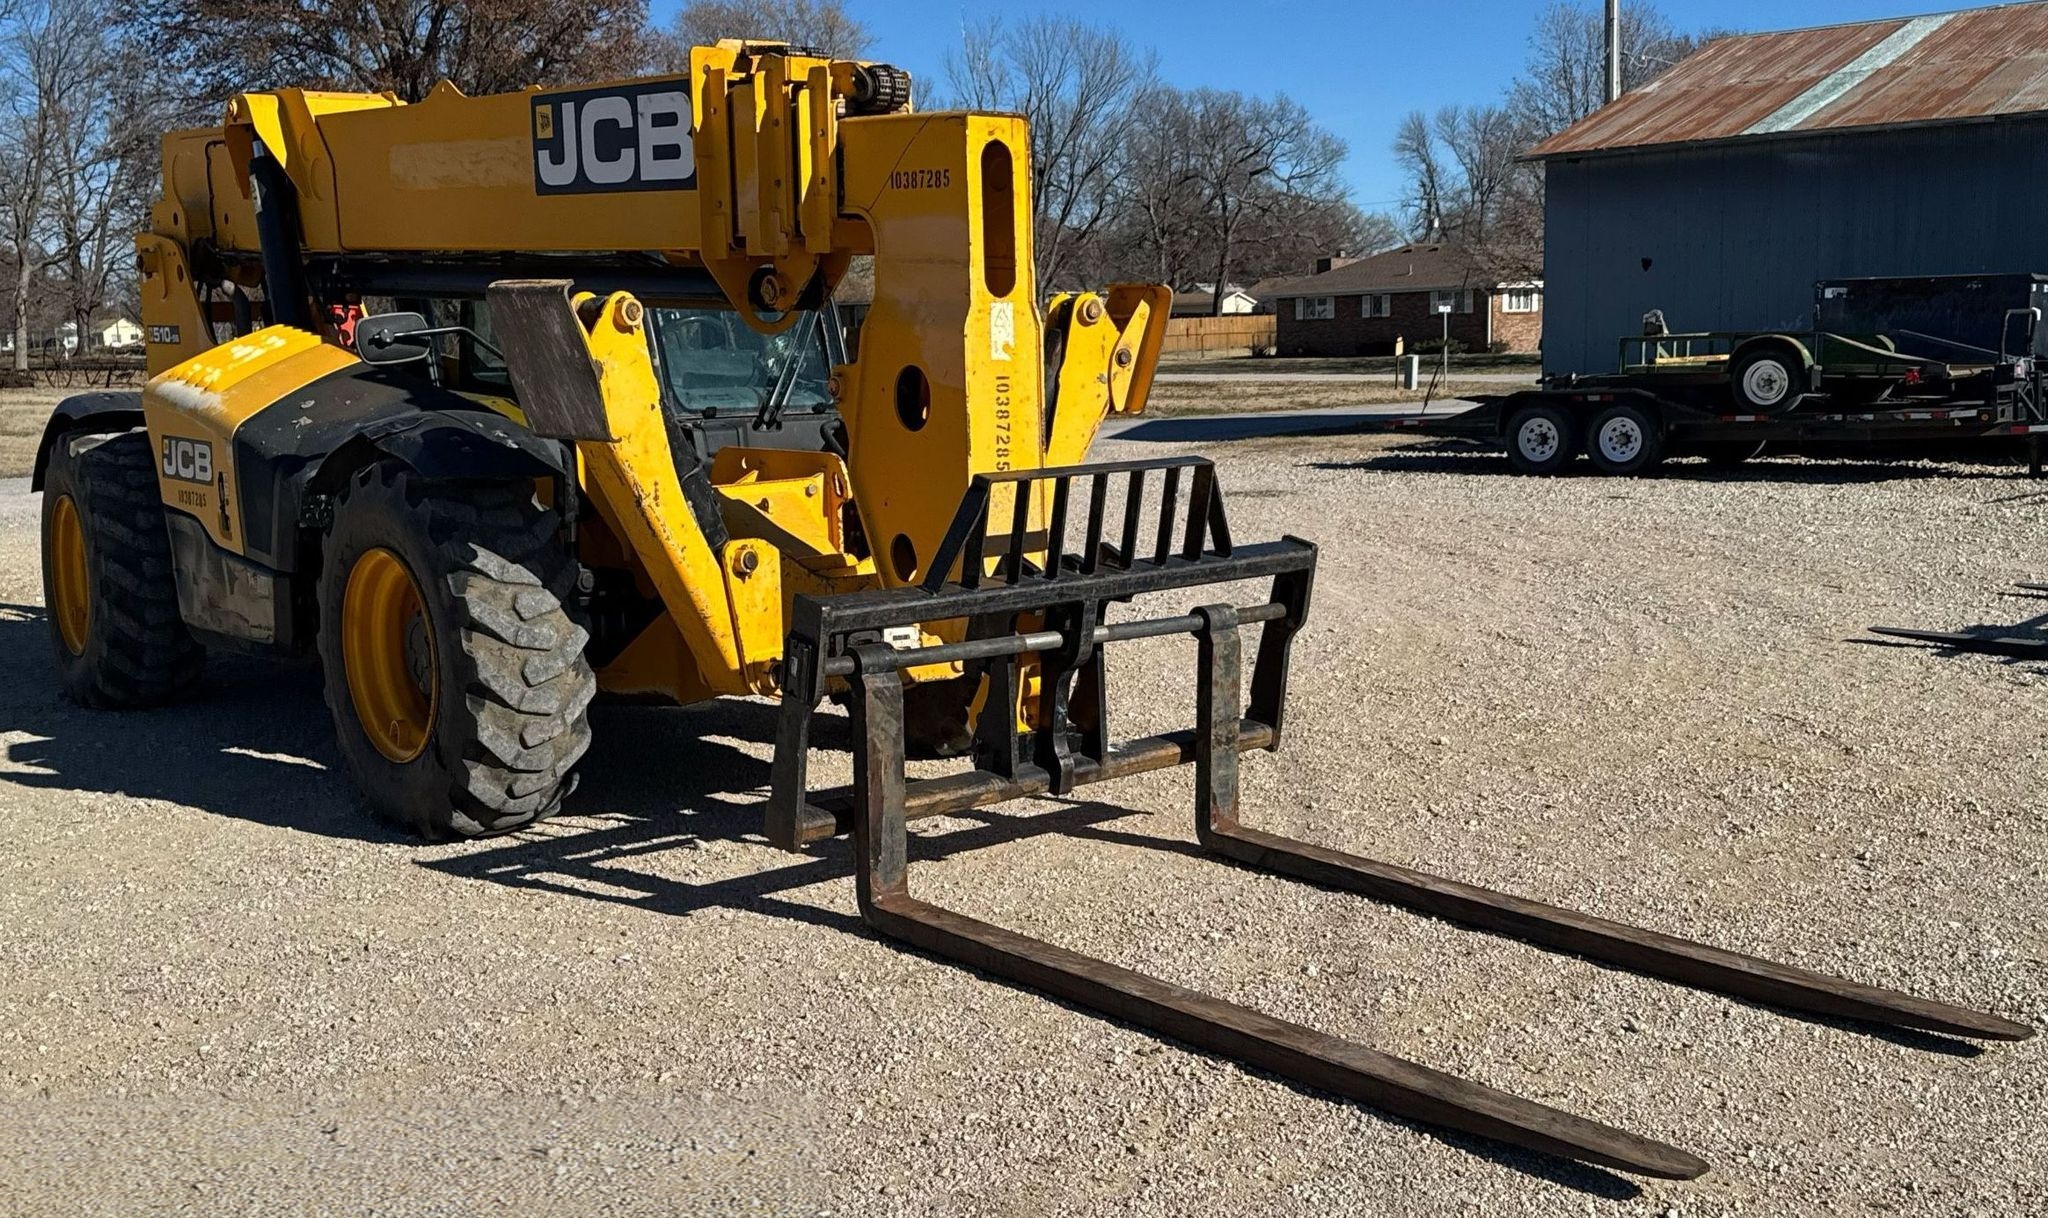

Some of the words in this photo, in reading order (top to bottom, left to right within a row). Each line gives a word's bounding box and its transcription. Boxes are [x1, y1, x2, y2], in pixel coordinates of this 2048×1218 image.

[537, 91, 695, 186] JCB
[890, 169, 950, 189] 10387285
[995, 375, 1011, 472] 10387285
[163, 439, 212, 482] JCB
